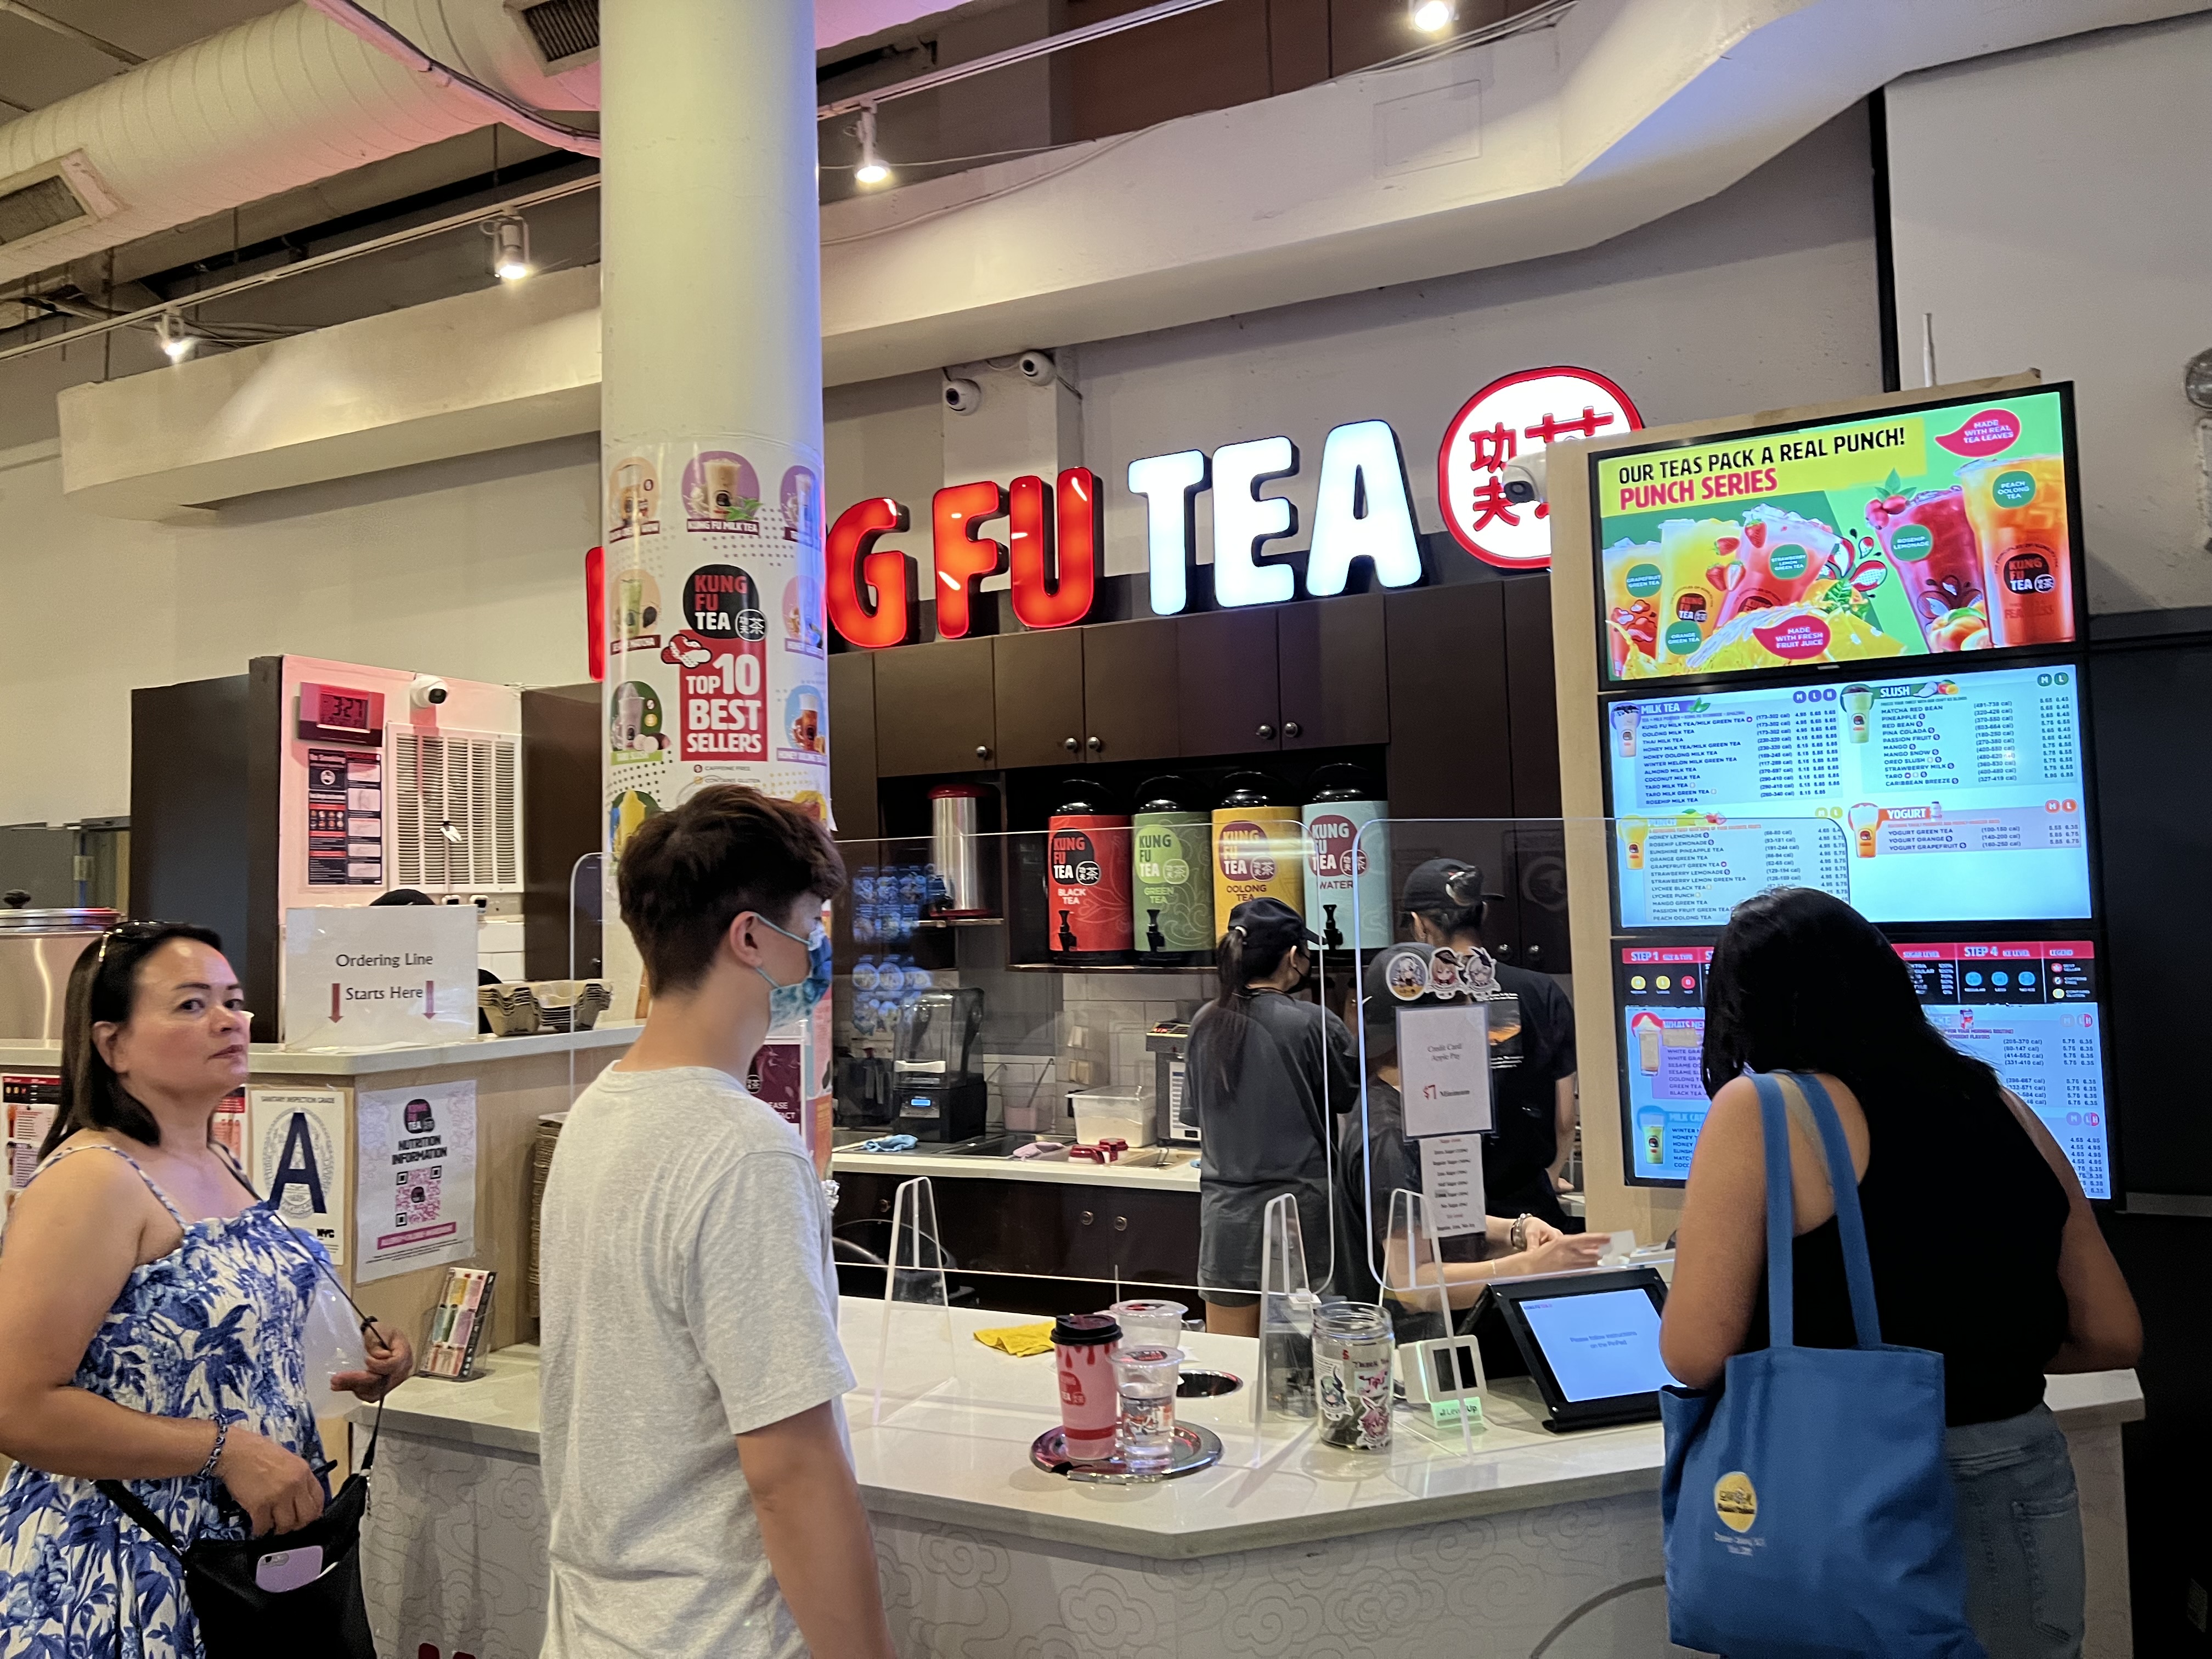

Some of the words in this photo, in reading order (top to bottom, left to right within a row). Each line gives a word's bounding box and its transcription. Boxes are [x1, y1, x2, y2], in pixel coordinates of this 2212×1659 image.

[1974, 420, 1998, 428] MADE
[1982, 432, 2013, 441] LEAVES
[1619, 464, 1654, 484] OUR
[1659, 456, 1703, 479] TEAS
[1709, 449, 1753, 472] PACK
[1762, 447, 1774, 464] A
[1780, 439, 1828, 461] REAL
[1834, 427, 1905, 454] PUNCH!
[1620, 479, 1694, 510] PUNCH
[1701, 468, 1778, 500] SERIES
[1997, 486, 2029, 494] OOLONG
[744, 523, 758, 532] TEA
[933, 467, 1099, 640] FU
[1128, 420, 1424, 616] TEA
[2009, 557, 2042, 569] KUNG
[2010, 571, 2024, 579] FU
[695, 575, 747, 594] KUNG
[2010, 579, 2033, 590] TEA
[695, 594, 718, 611] FU
[695, 612, 731, 630] TEA
[1679, 611, 1694, 619] TEA
[686, 676, 720, 694] TOP
[713, 653, 760, 695] 10
[1880, 686, 1910, 697] SLUSH
[689, 699, 761, 730] BEST
[1641, 704, 1661, 714] MILK
[1663, 703, 1680, 712] TEA
[687, 733, 761, 752] SELLERS
[1887, 808, 1926, 819] YOGURT
[1223, 830, 1259, 844] KUNG
[1312, 823, 1349, 839] KUNG
[1053, 837, 1085, 850] KUNG
[1139, 834, 1171, 848] KUNG
[1054, 851, 1066, 864] FU
[1140, 850, 1150, 862] FU
[1224, 845, 1238, 860] FU
[1224, 860, 1247, 874] TEA
[1312, 855, 1337, 870] TEA
[1054, 865, 1073, 878] TEA
[1139, 863, 1160, 877] TEA
[1144, 887, 1174, 895] GREEN
[1320, 881, 1353, 889] WATER
[1631, 952, 1651, 961] STEP
[1653, 951, 1658, 960] 1
[1965, 946, 1989, 957] STEP
[1990, 946, 1998, 956] 4
[336, 955, 400, 968] Ordering
[405, 953, 433, 965] Line
[346, 988, 385, 1000] Starts
[390, 986, 422, 998] Here
[1423, 1085, 1437, 1100] $7
[398, 1135, 441, 1150] NUTRITION
[392, 1147, 447, 1165] INFORMATION
[267, 1113, 326, 1214] A
[317, 1229, 334, 1238] NYC
